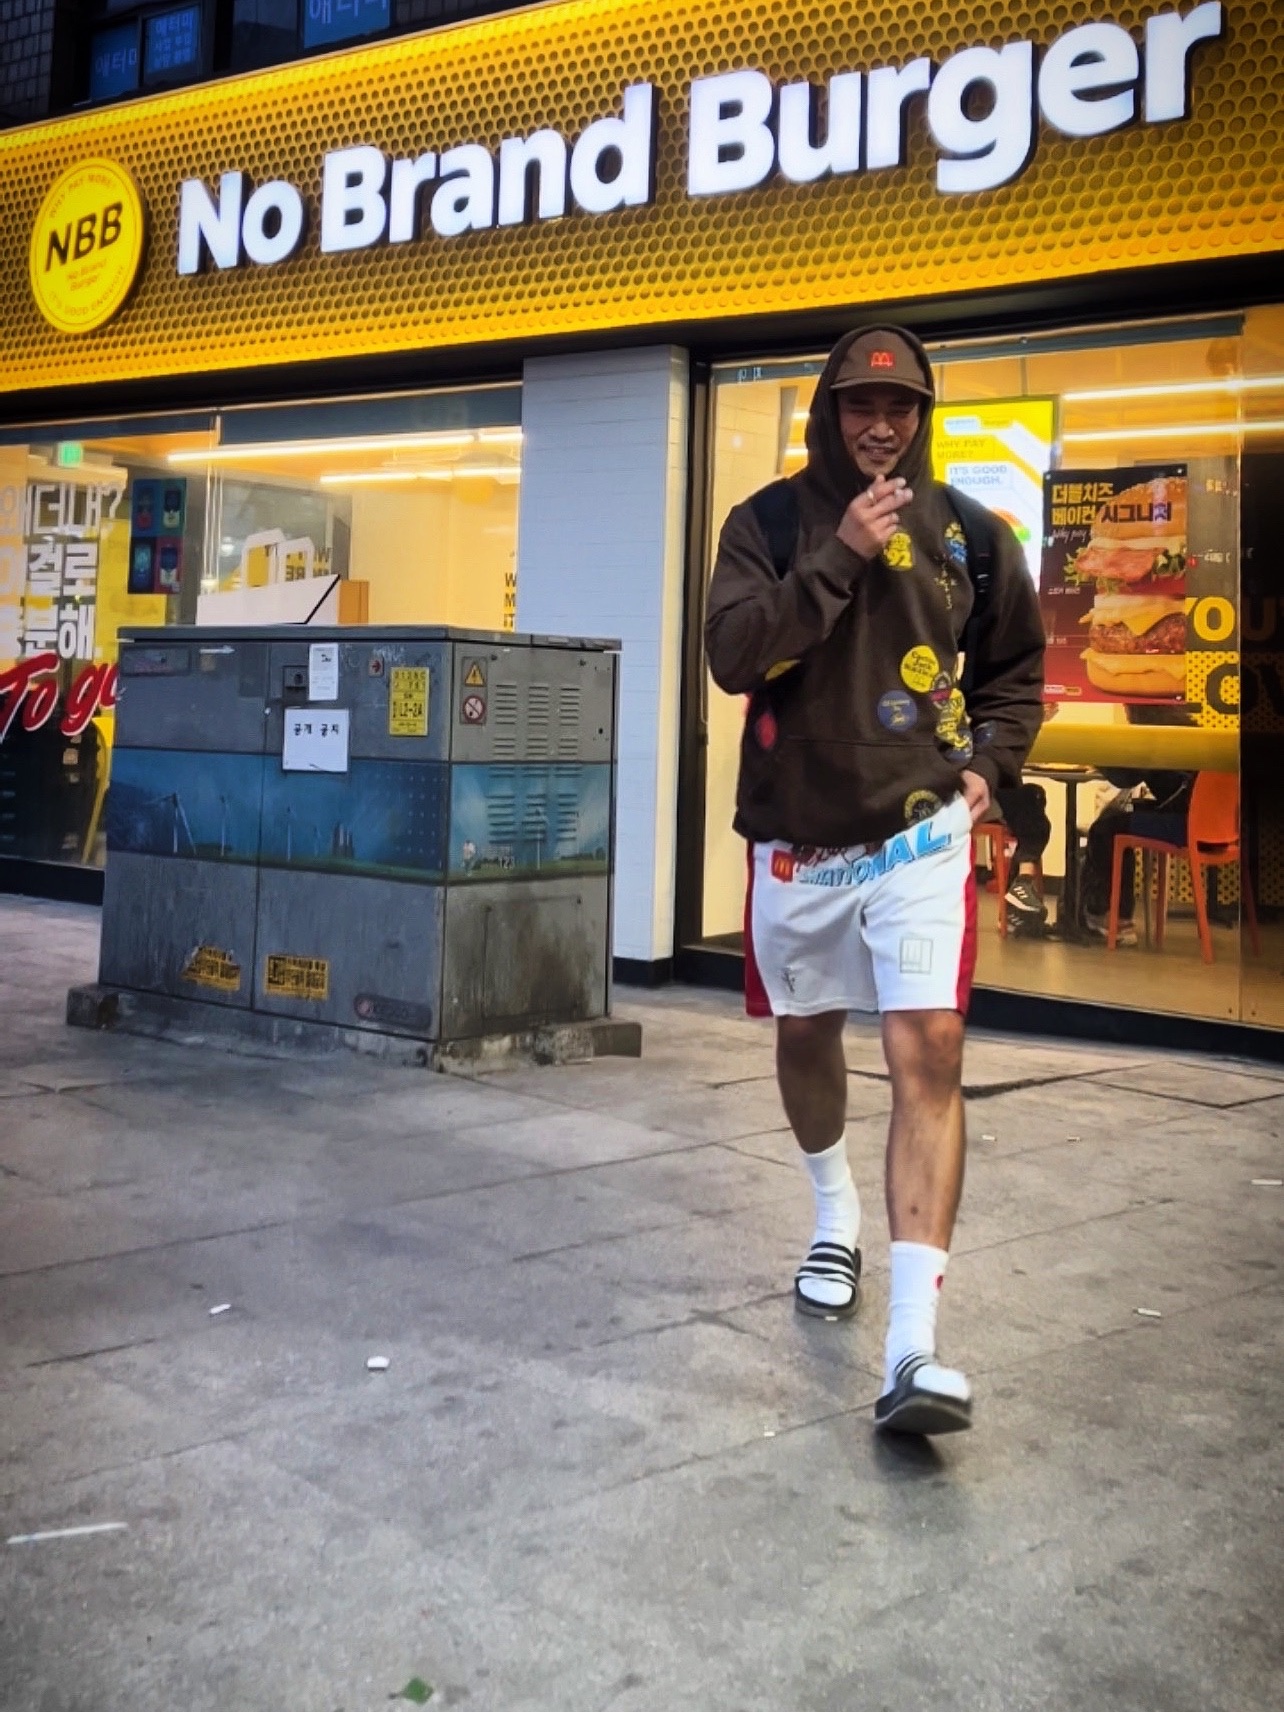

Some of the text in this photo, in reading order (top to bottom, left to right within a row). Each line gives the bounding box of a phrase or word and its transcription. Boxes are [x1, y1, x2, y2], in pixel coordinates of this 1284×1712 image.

[178, 1, 1222, 276] No Brand Burger
[44, 200, 123, 273] NBB
[972, 465, 1008, 475] GOOD
[1052, 482, 1114, 504] 더블치즈
[1052, 504, 1096, 526] 베이컨
